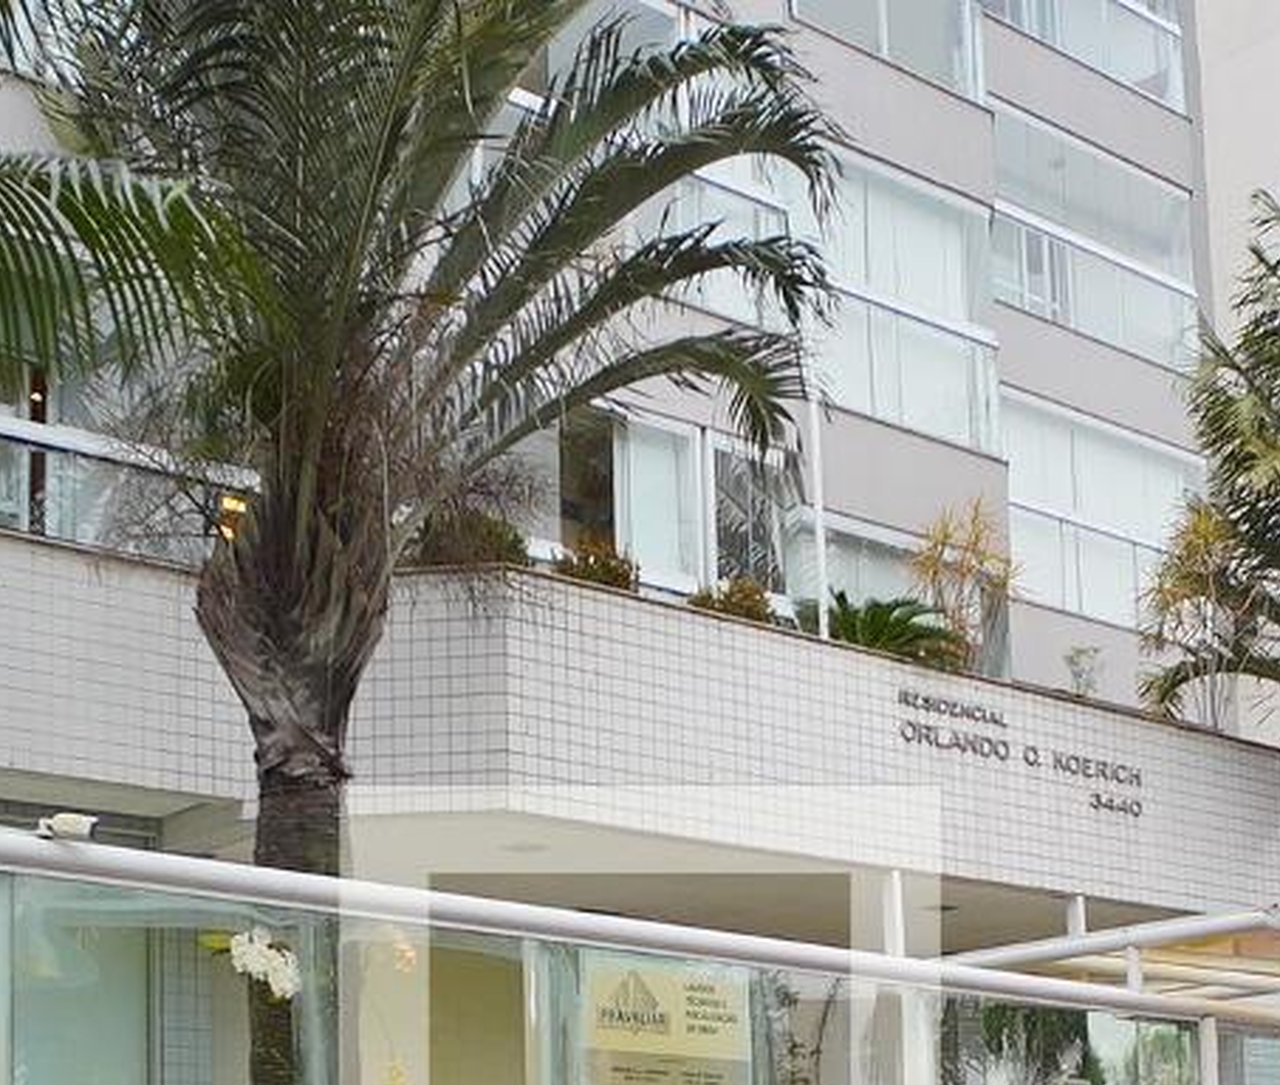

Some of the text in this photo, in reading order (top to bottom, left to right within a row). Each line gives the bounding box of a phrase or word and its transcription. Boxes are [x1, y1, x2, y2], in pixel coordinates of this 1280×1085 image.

[898, 689, 1007, 728] RESIDENCIAL
[900, 720, 1009, 761] ORLANDO
[1051, 750, 1142, 788] KOERICH
[1089, 793, 1142, 818] 3440
